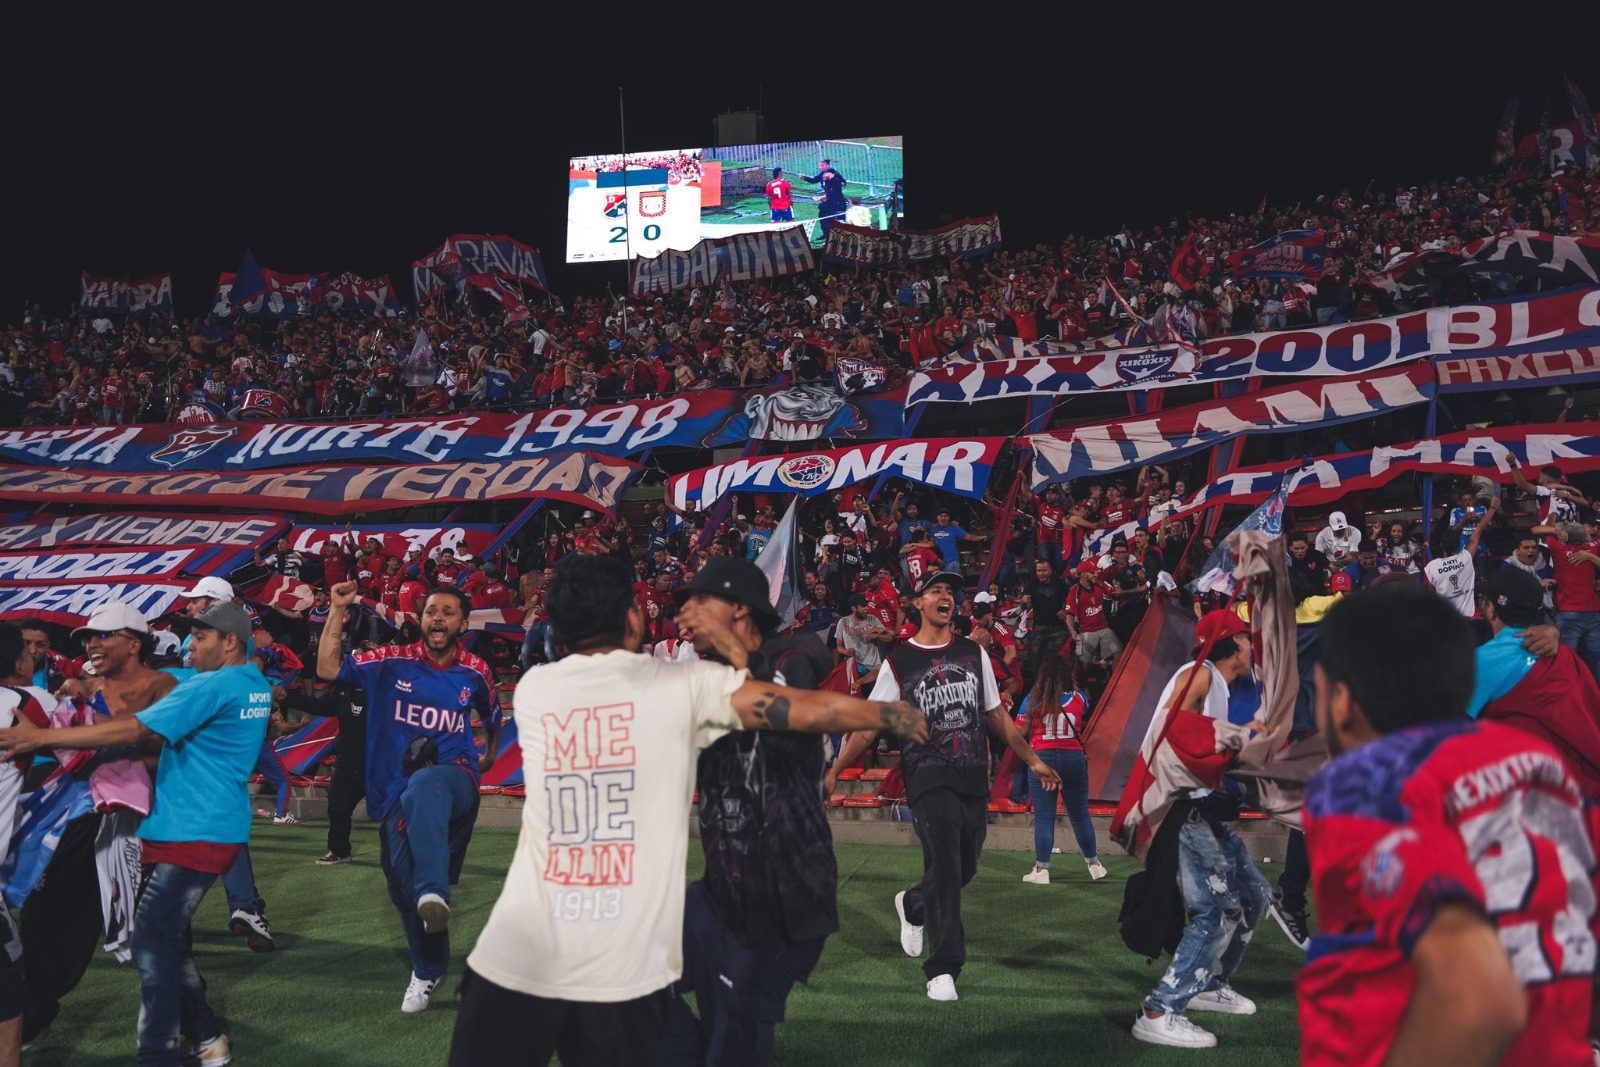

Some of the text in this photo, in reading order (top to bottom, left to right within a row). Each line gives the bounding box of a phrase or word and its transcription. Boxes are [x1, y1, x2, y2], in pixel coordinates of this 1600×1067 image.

[608, 224, 661, 244] 2 0
[1197, 309, 1432, 379] 2001
[226, 415, 479, 464] NORTE
[486, 397, 691, 459] 1998
[1438, 562, 1465, 575] DOPING
[1442, 559, 1458, 567] ANTI
[394, 699, 465, 734] LEONA
[1042, 711, 1077, 740] 10
[541, 702, 636, 773] ME
[545, 769, 636, 847] DE
[542, 842, 636, 887] LLIN
